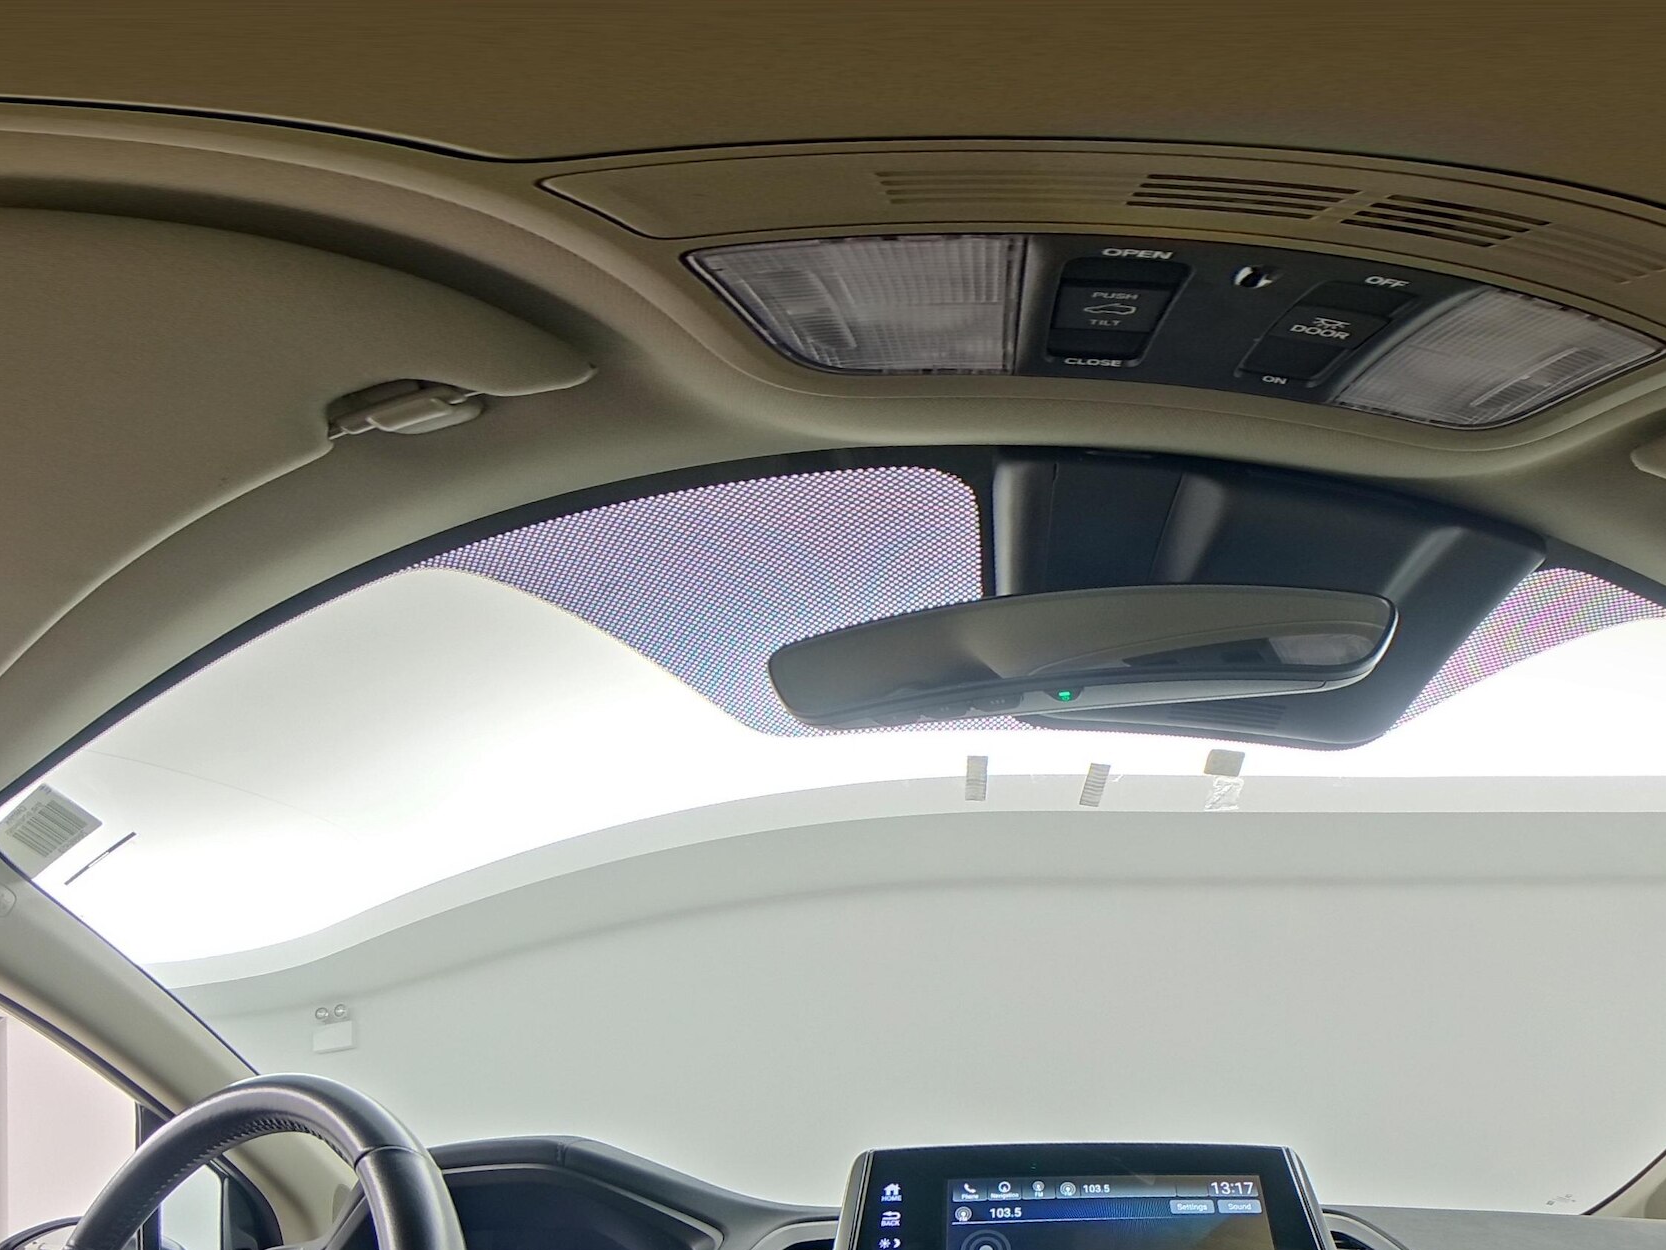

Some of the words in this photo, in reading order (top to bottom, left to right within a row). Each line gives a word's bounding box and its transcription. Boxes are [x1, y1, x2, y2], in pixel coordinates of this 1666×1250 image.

[1101, 248, 1174, 260] OPEN
[1365, 276, 1410, 288] OFF
[1091, 291, 1139, 300] PUSH
[1089, 319, 1121, 327] TILT
[1289, 324, 1351, 340] DOOR
[1064, 357, 1122, 368] CLOSE
[1262, 375, 1287, 385] ON
[1083, 1184, 1110, 1193] 103.5
[1210, 1181, 1254, 1195] 13:17
[1177, 1203, 1208, 1211] Settings
[1228, 1203, 1252, 1211] Sound
[990, 1207, 1022, 1219] 103.5
[881, 1219, 900, 1227] BACK
